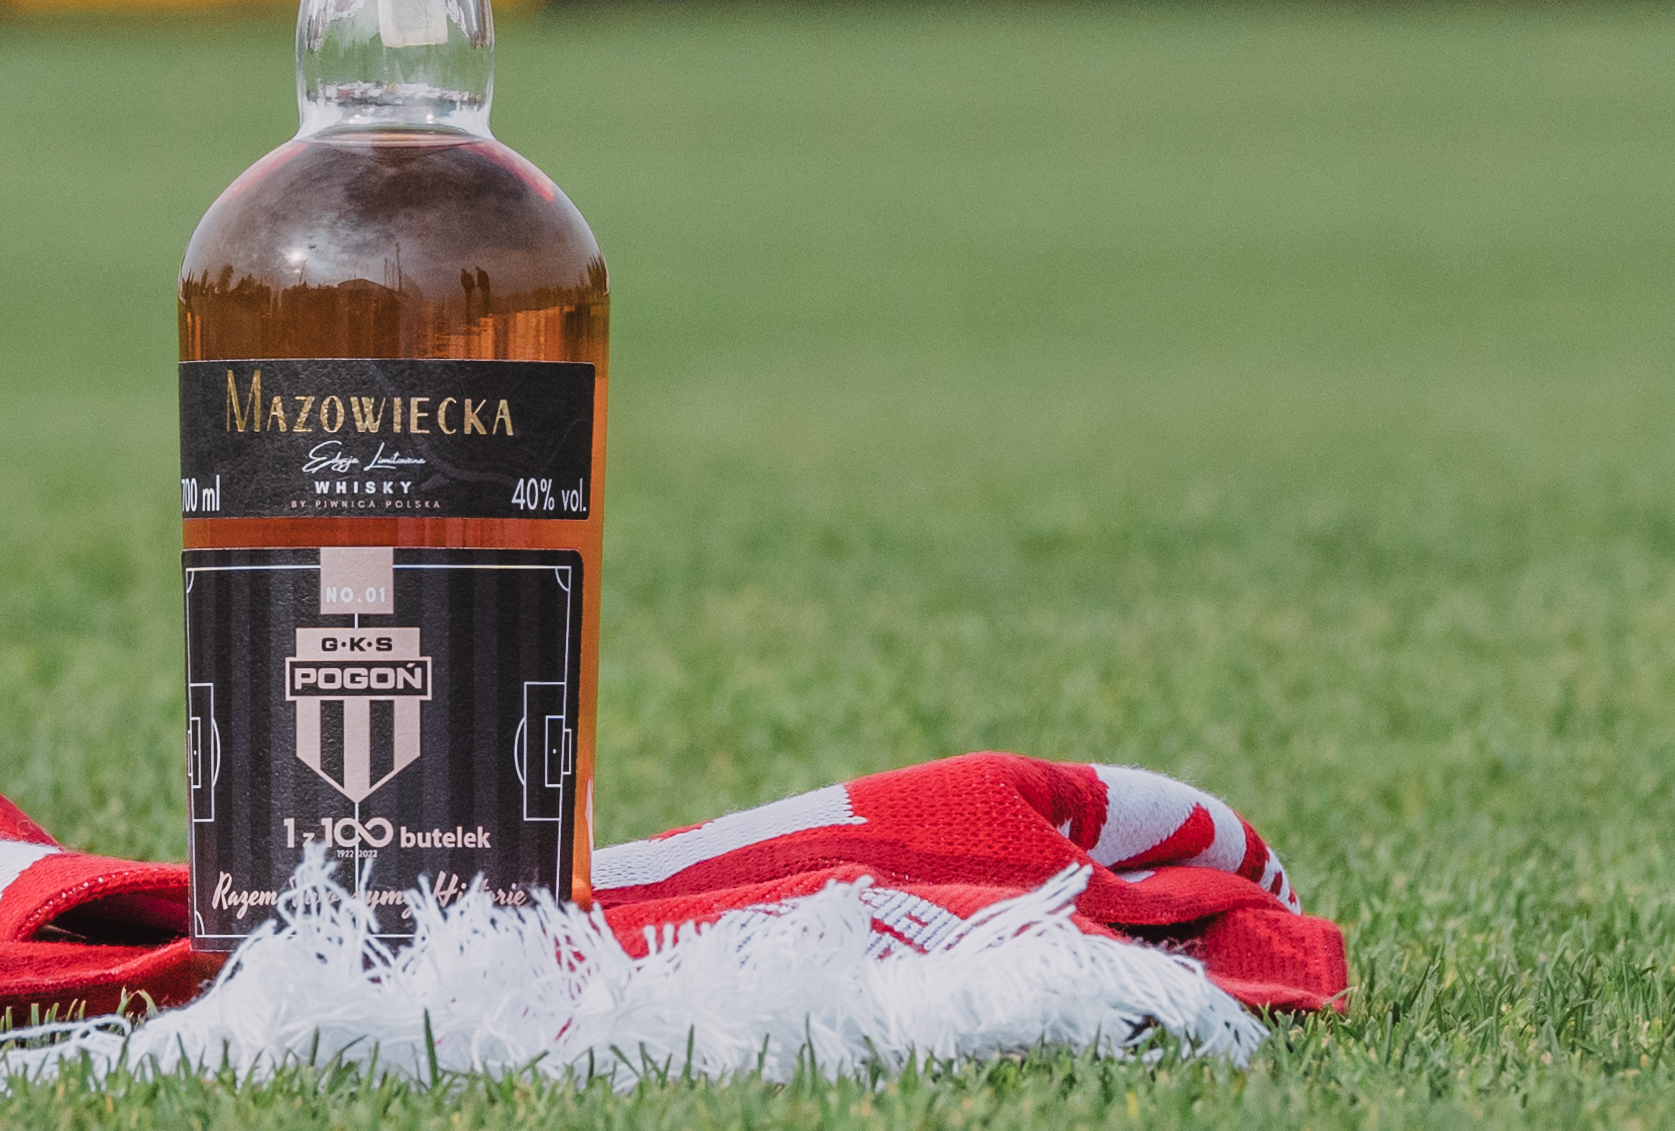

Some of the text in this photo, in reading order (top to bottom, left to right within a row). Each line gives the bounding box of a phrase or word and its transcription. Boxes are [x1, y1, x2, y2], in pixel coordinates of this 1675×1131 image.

[202, 474, 221, 511] ml
[314, 480, 412, 494] WHISKY
[511, 477, 587, 512] 40% vol.
[291, 500, 441, 508] BY PIWNICA POLSKA
[294, 663, 422, 690] POGOŃ
[283, 817, 295, 848] 1
[400, 826, 491, 848] butelek
[336, 849, 378, 858] 1922 2022
[212, 870, 278, 920] Razem
